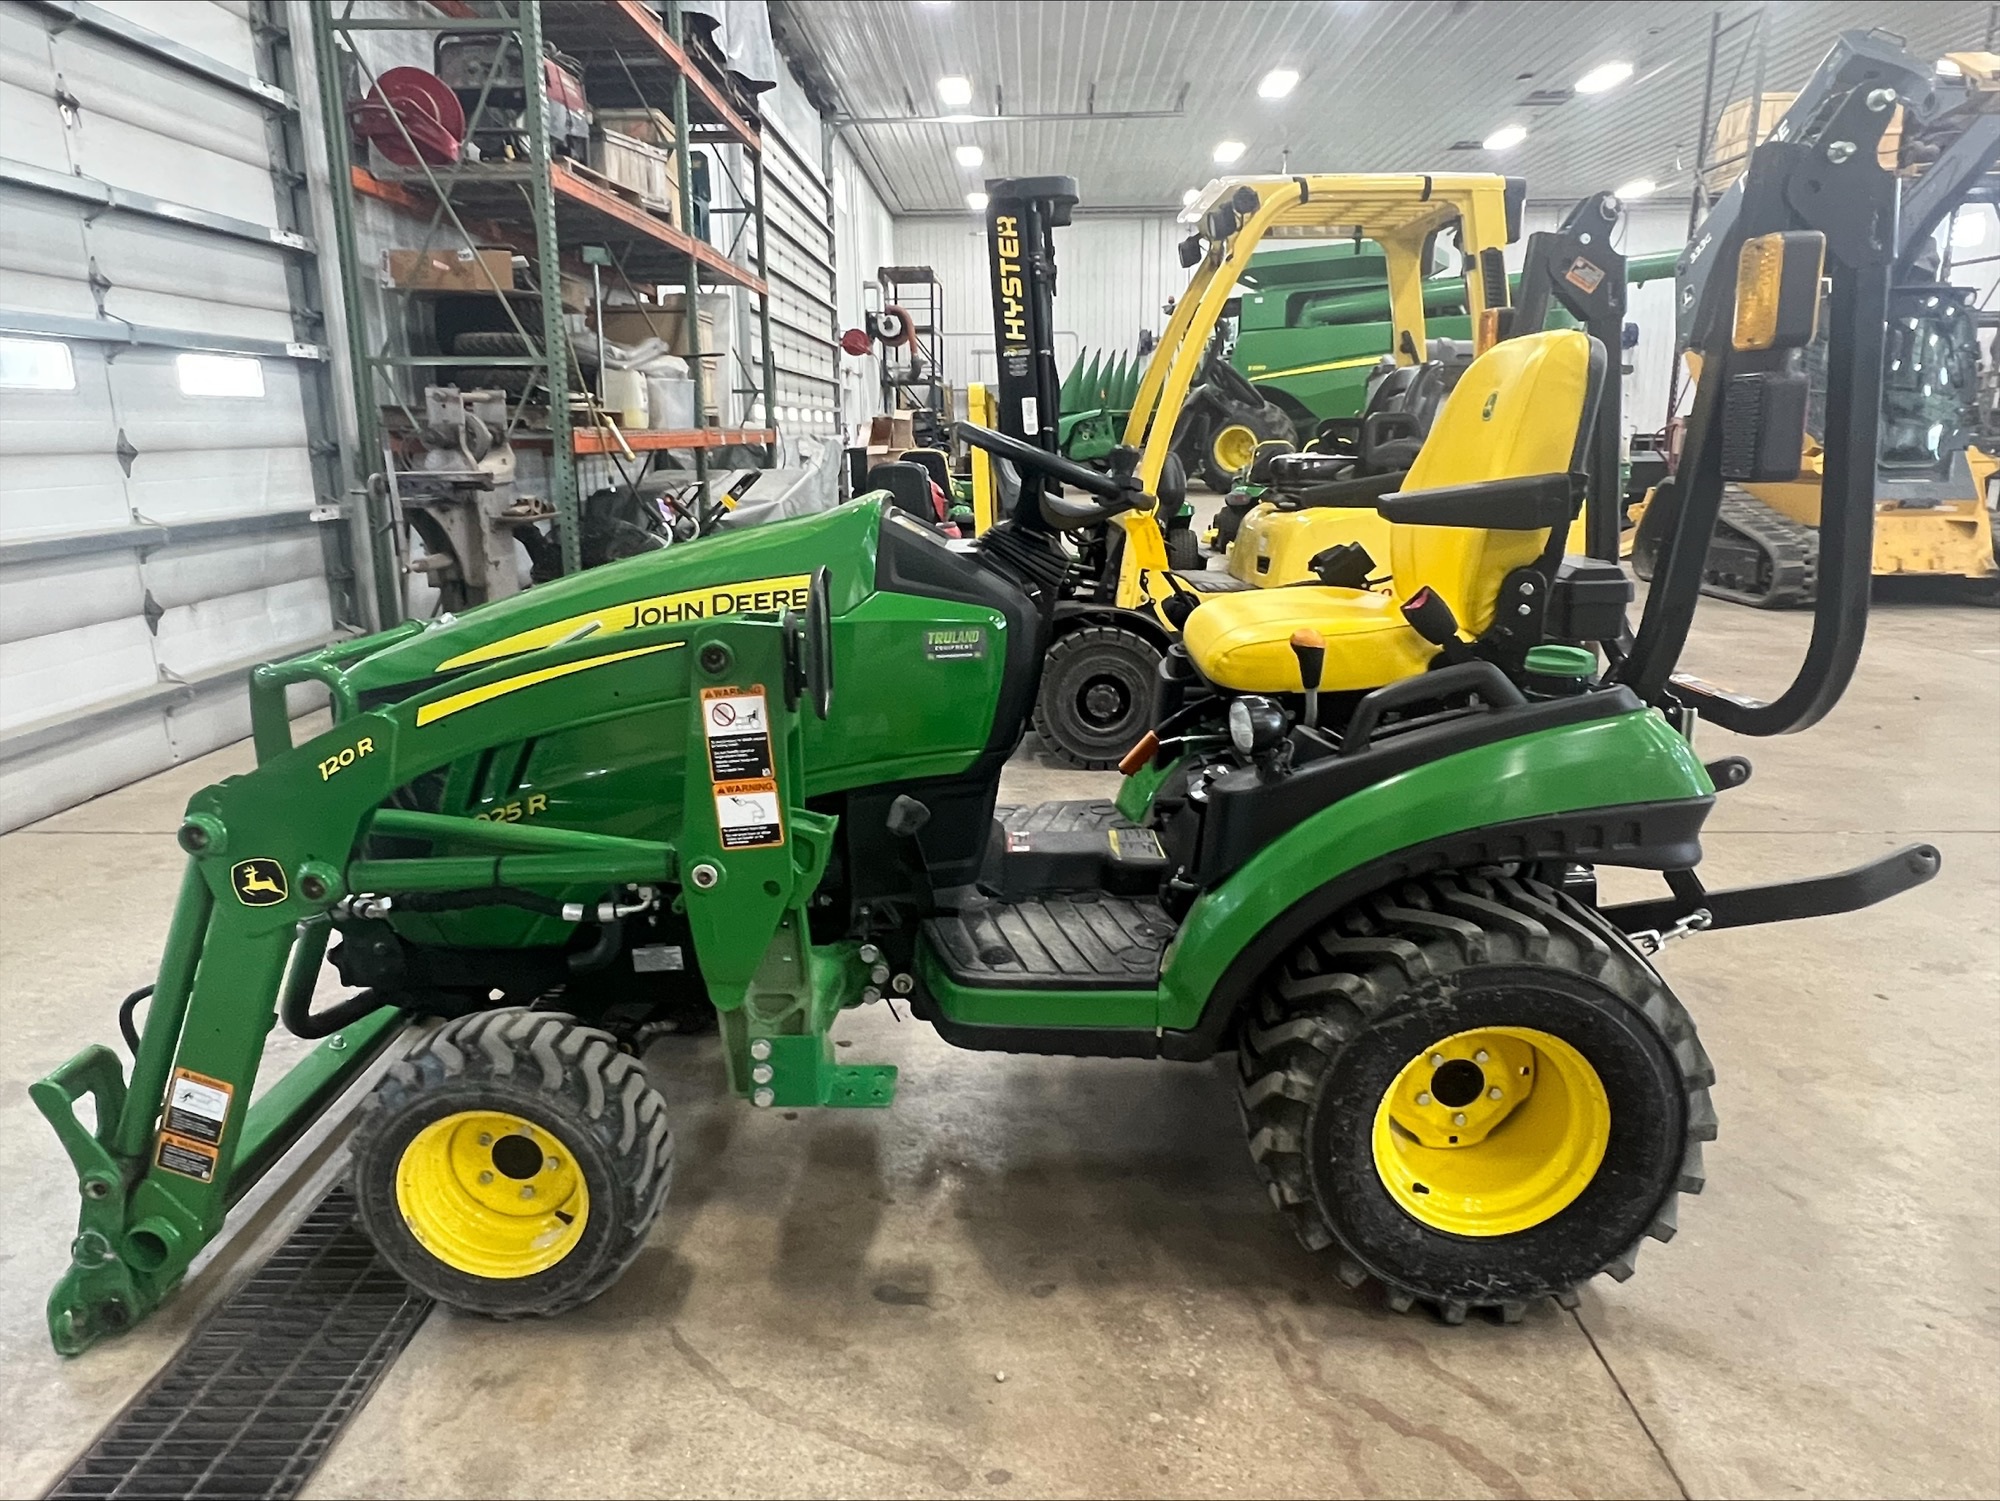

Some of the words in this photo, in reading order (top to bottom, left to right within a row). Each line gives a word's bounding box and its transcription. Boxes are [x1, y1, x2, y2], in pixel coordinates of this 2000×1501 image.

[997, 215, 1027, 341] HYSTER
[624, 600, 704, 630] JOHN
[712, 588, 809, 616] DEERE
[928, 631, 979, 645] TRULAND
[317, 747, 356, 782] 120
[356, 736, 375, 758] R
[527, 793, 547, 815] R
[725, 782, 774, 794] WARNING
